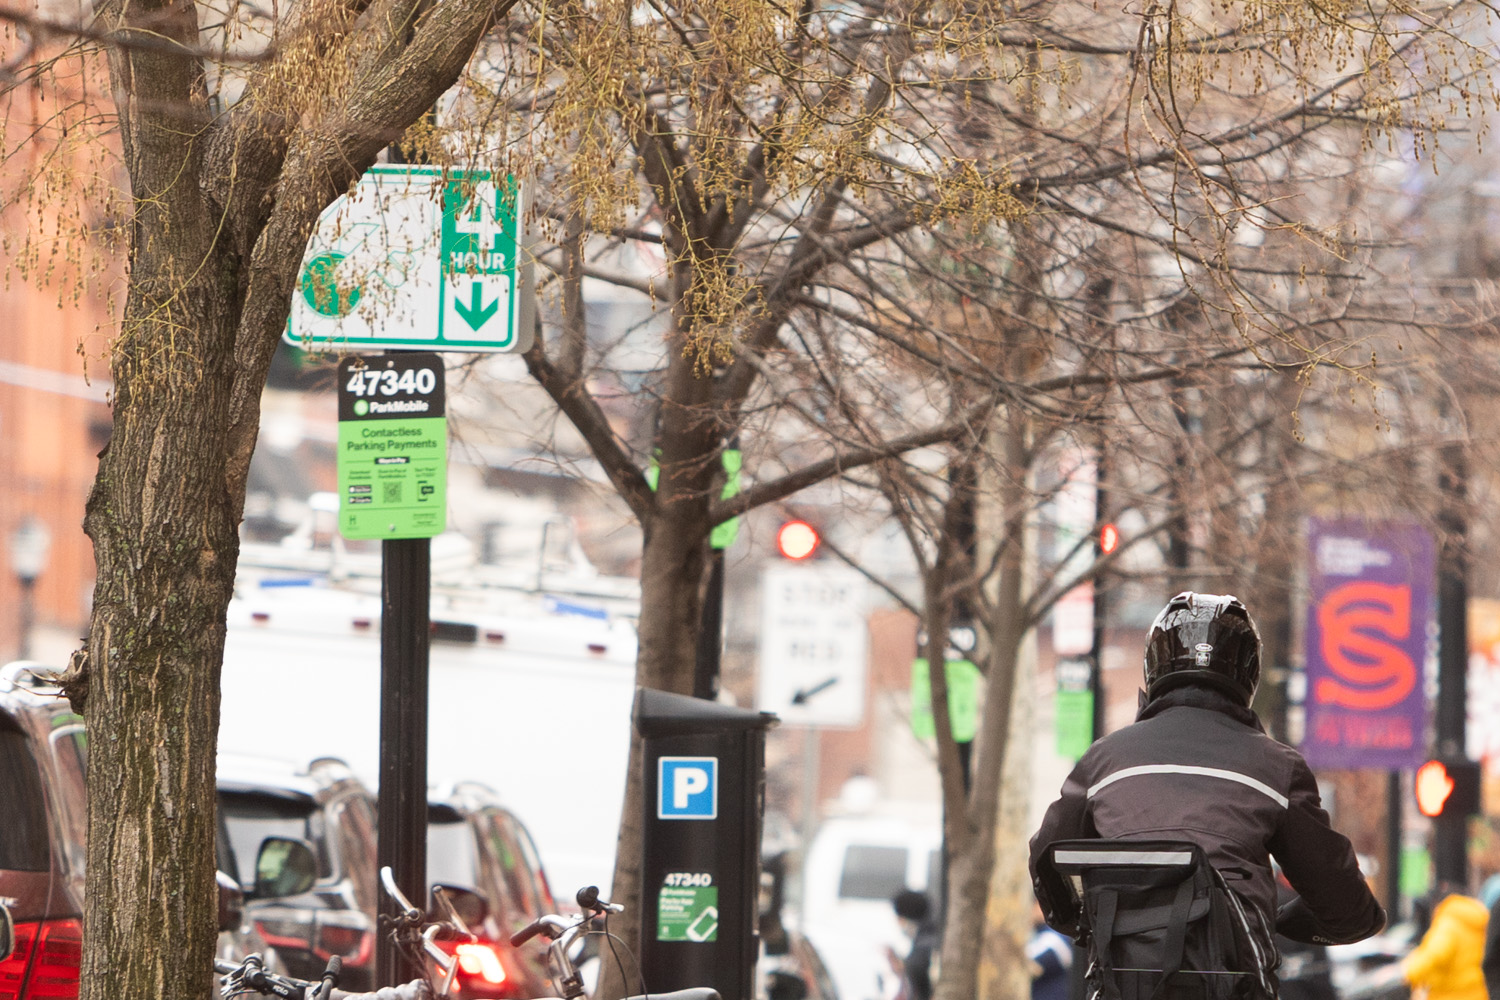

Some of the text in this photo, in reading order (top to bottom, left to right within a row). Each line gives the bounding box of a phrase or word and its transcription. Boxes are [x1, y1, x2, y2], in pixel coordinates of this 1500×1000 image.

[455, 180, 503, 250] 4
[450, 251, 507, 270] HOUR
[346, 368, 436, 396] 47340
[369, 400, 429, 413] ParkMobile
[361, 428, 423, 438] Contactless
[347, 439, 438, 452] Parking Payments
[673, 767, 709, 809] P
[664, 873, 712, 887] 47340
